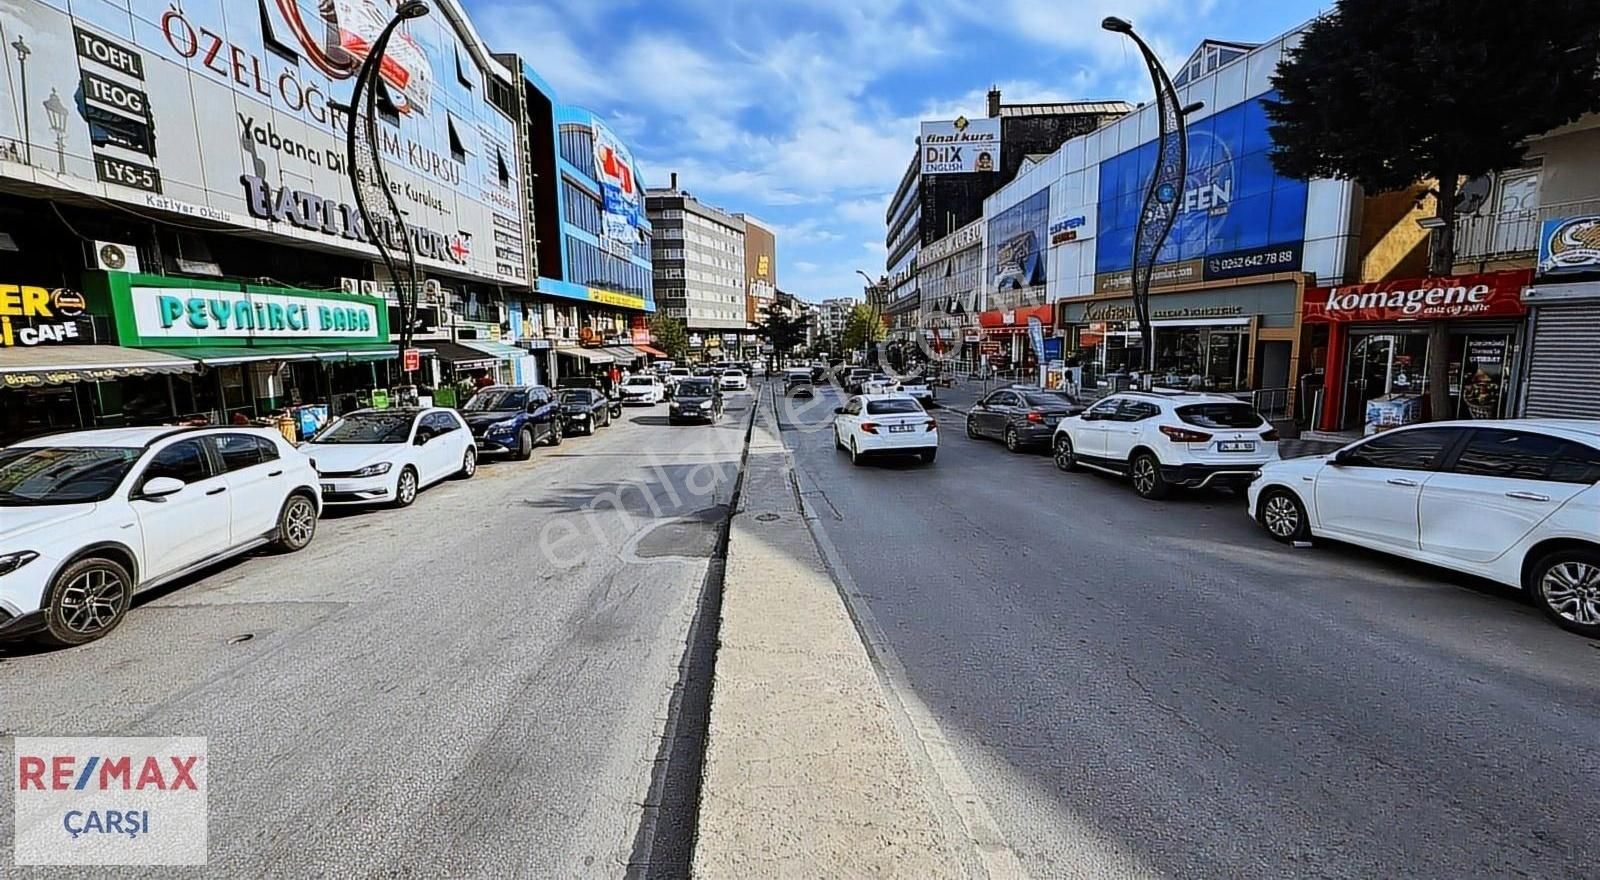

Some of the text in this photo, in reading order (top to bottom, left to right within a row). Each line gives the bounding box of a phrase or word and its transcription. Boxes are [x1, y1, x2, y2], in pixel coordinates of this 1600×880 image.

[80, 33, 139, 75] TOEFL
[89, 76, 143, 113] TEOG
[161, 3, 272, 98] ÖZEL
[407, 138, 461, 186] KURSU
[238, 112, 322, 167] Yabancı
[925, 132, 994, 143] final kurs
[103, 159, 153, 188] LYS-5
[200, 207, 231, 222] Okulu
[1264, 252, 1278, 265] 78
[1326, 283, 1489, 314] komagene
[319, 305, 371, 331] BABA
[19, 321, 79, 346] CAFE
